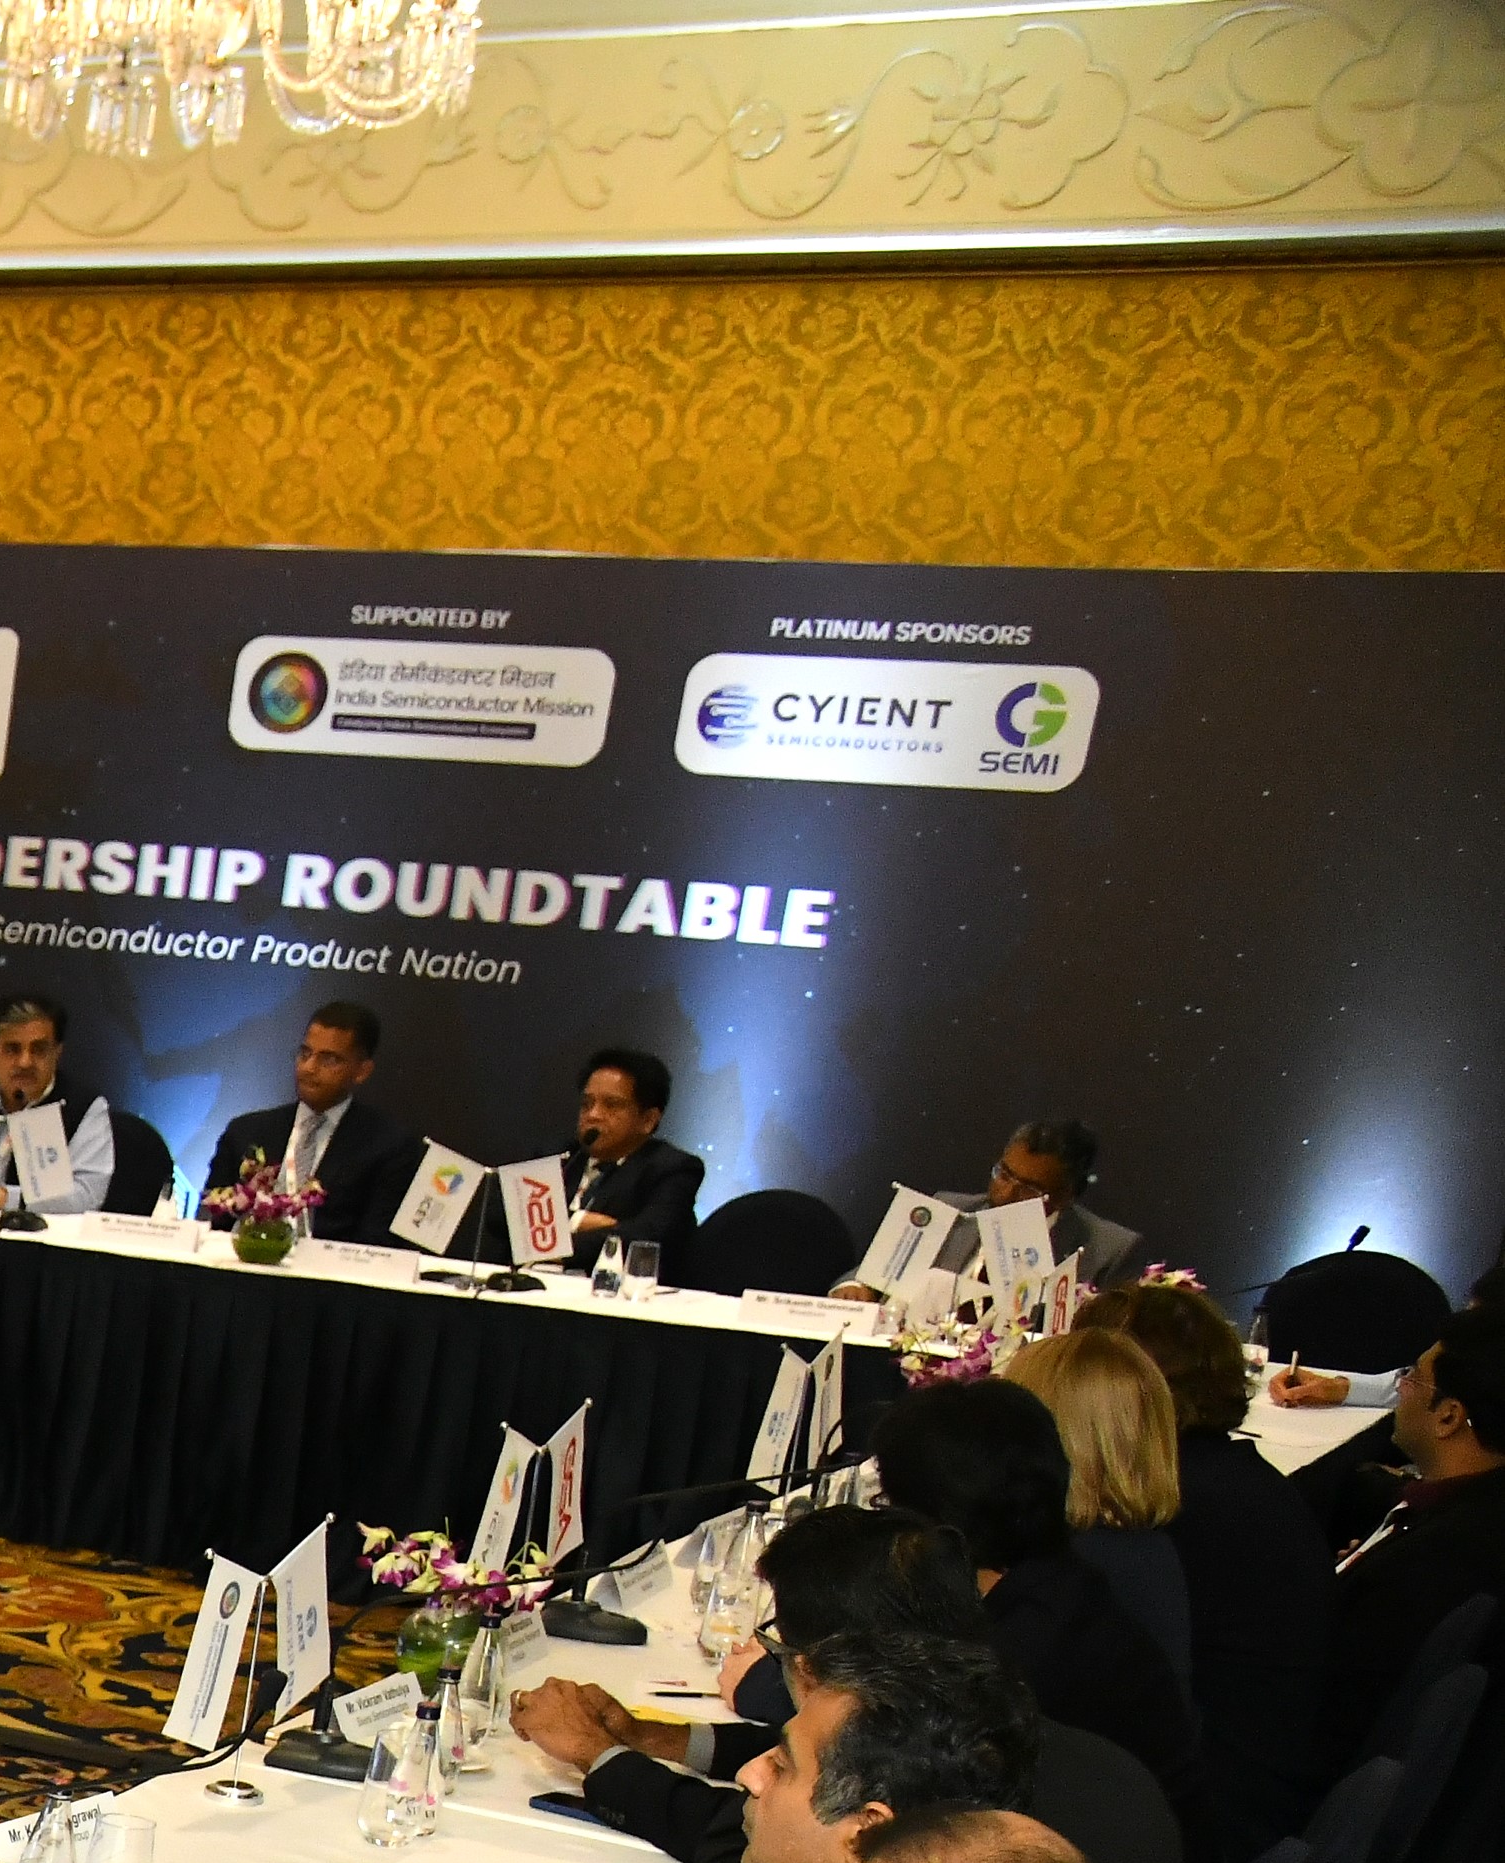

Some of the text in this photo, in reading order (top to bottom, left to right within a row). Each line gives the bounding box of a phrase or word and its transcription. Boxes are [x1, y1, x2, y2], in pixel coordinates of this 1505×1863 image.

[351, 605, 511, 629] SUPPORTED BY
[770, 617, 1032, 646] PLATINUM SPONSORS
[334, 689, 594, 718] India Semiconductor Mission
[772, 693, 953, 729] CYIENT
[766, 736, 944, 753] SEMICONDUCTORS
[979, 751, 1060, 776] SEMI
[281, 852, 836, 949] ROUNDTABLE
[250, 933, 392, 974] Product
[399, 946, 522, 985] Nation
[68, 1804, 101, 1829] grawal
